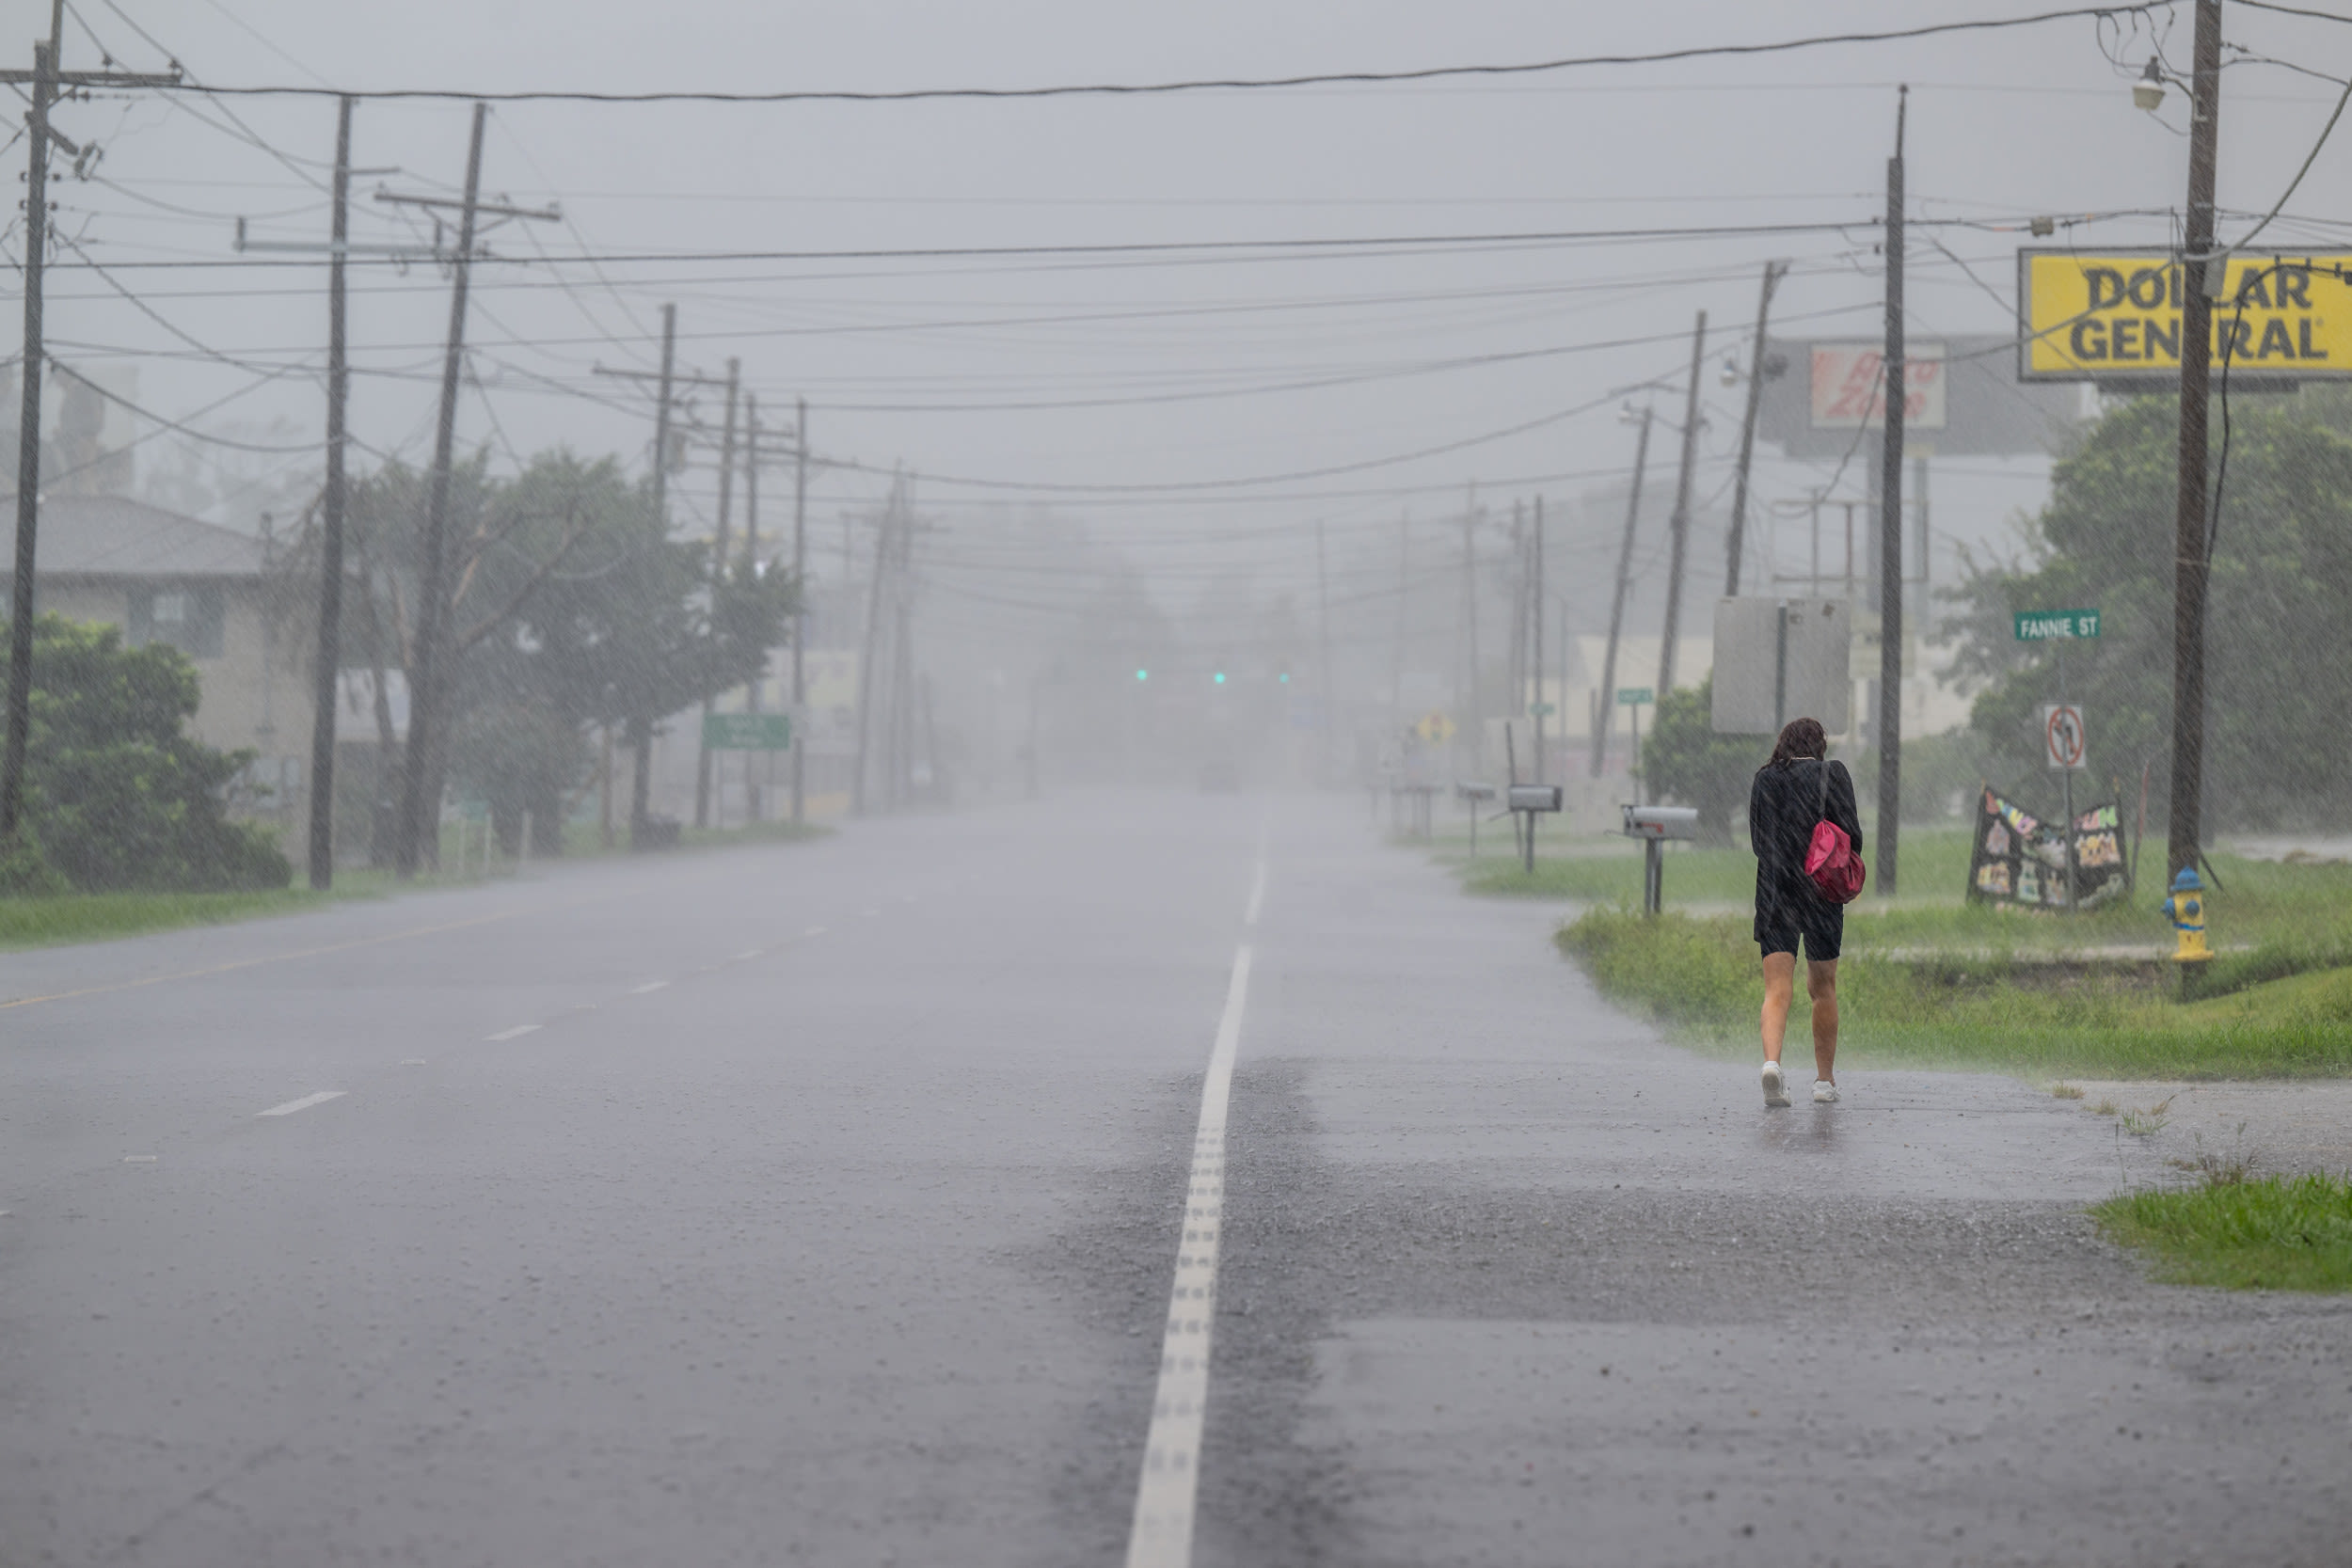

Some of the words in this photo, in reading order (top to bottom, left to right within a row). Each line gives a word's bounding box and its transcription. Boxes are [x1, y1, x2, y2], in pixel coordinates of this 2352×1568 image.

[2070, 317, 2328, 361] GENRAL
[2021, 618, 2074, 638] FANNIE
[2078, 616, 2097, 636] ST
